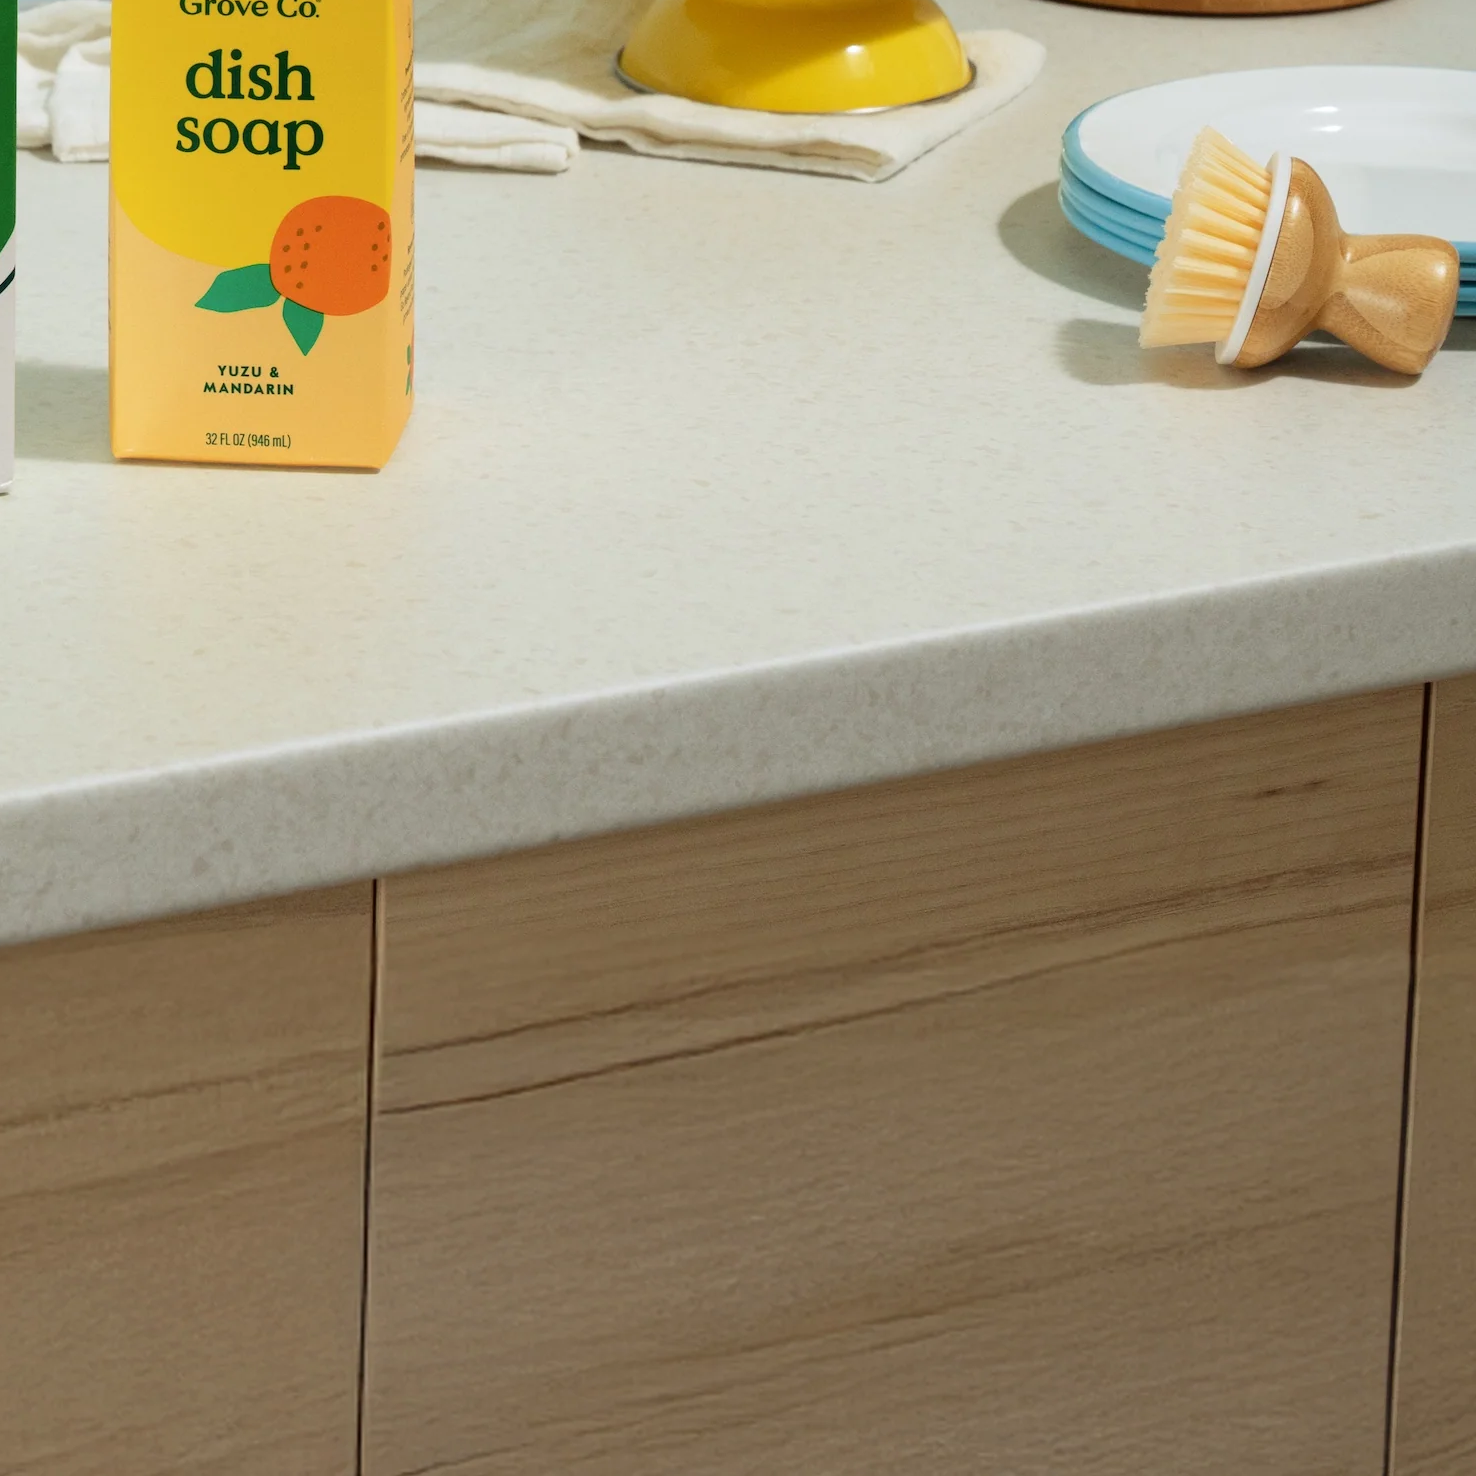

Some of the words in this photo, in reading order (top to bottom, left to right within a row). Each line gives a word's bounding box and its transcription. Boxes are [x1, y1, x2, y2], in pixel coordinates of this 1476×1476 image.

[185, 48, 315, 101] dish
[175, 116, 324, 171] soap
[217, 365, 262, 378] YUZU
[269, 366, 280, 378] &
[203, 381, 294, 395] MANDARIN
[205, 432, 218, 445] 32
[220, 432, 231, 446] FL
[232, 433, 245, 446] OZ
[247, 433, 270, 448] (946
[272, 434, 292, 449] mL)
